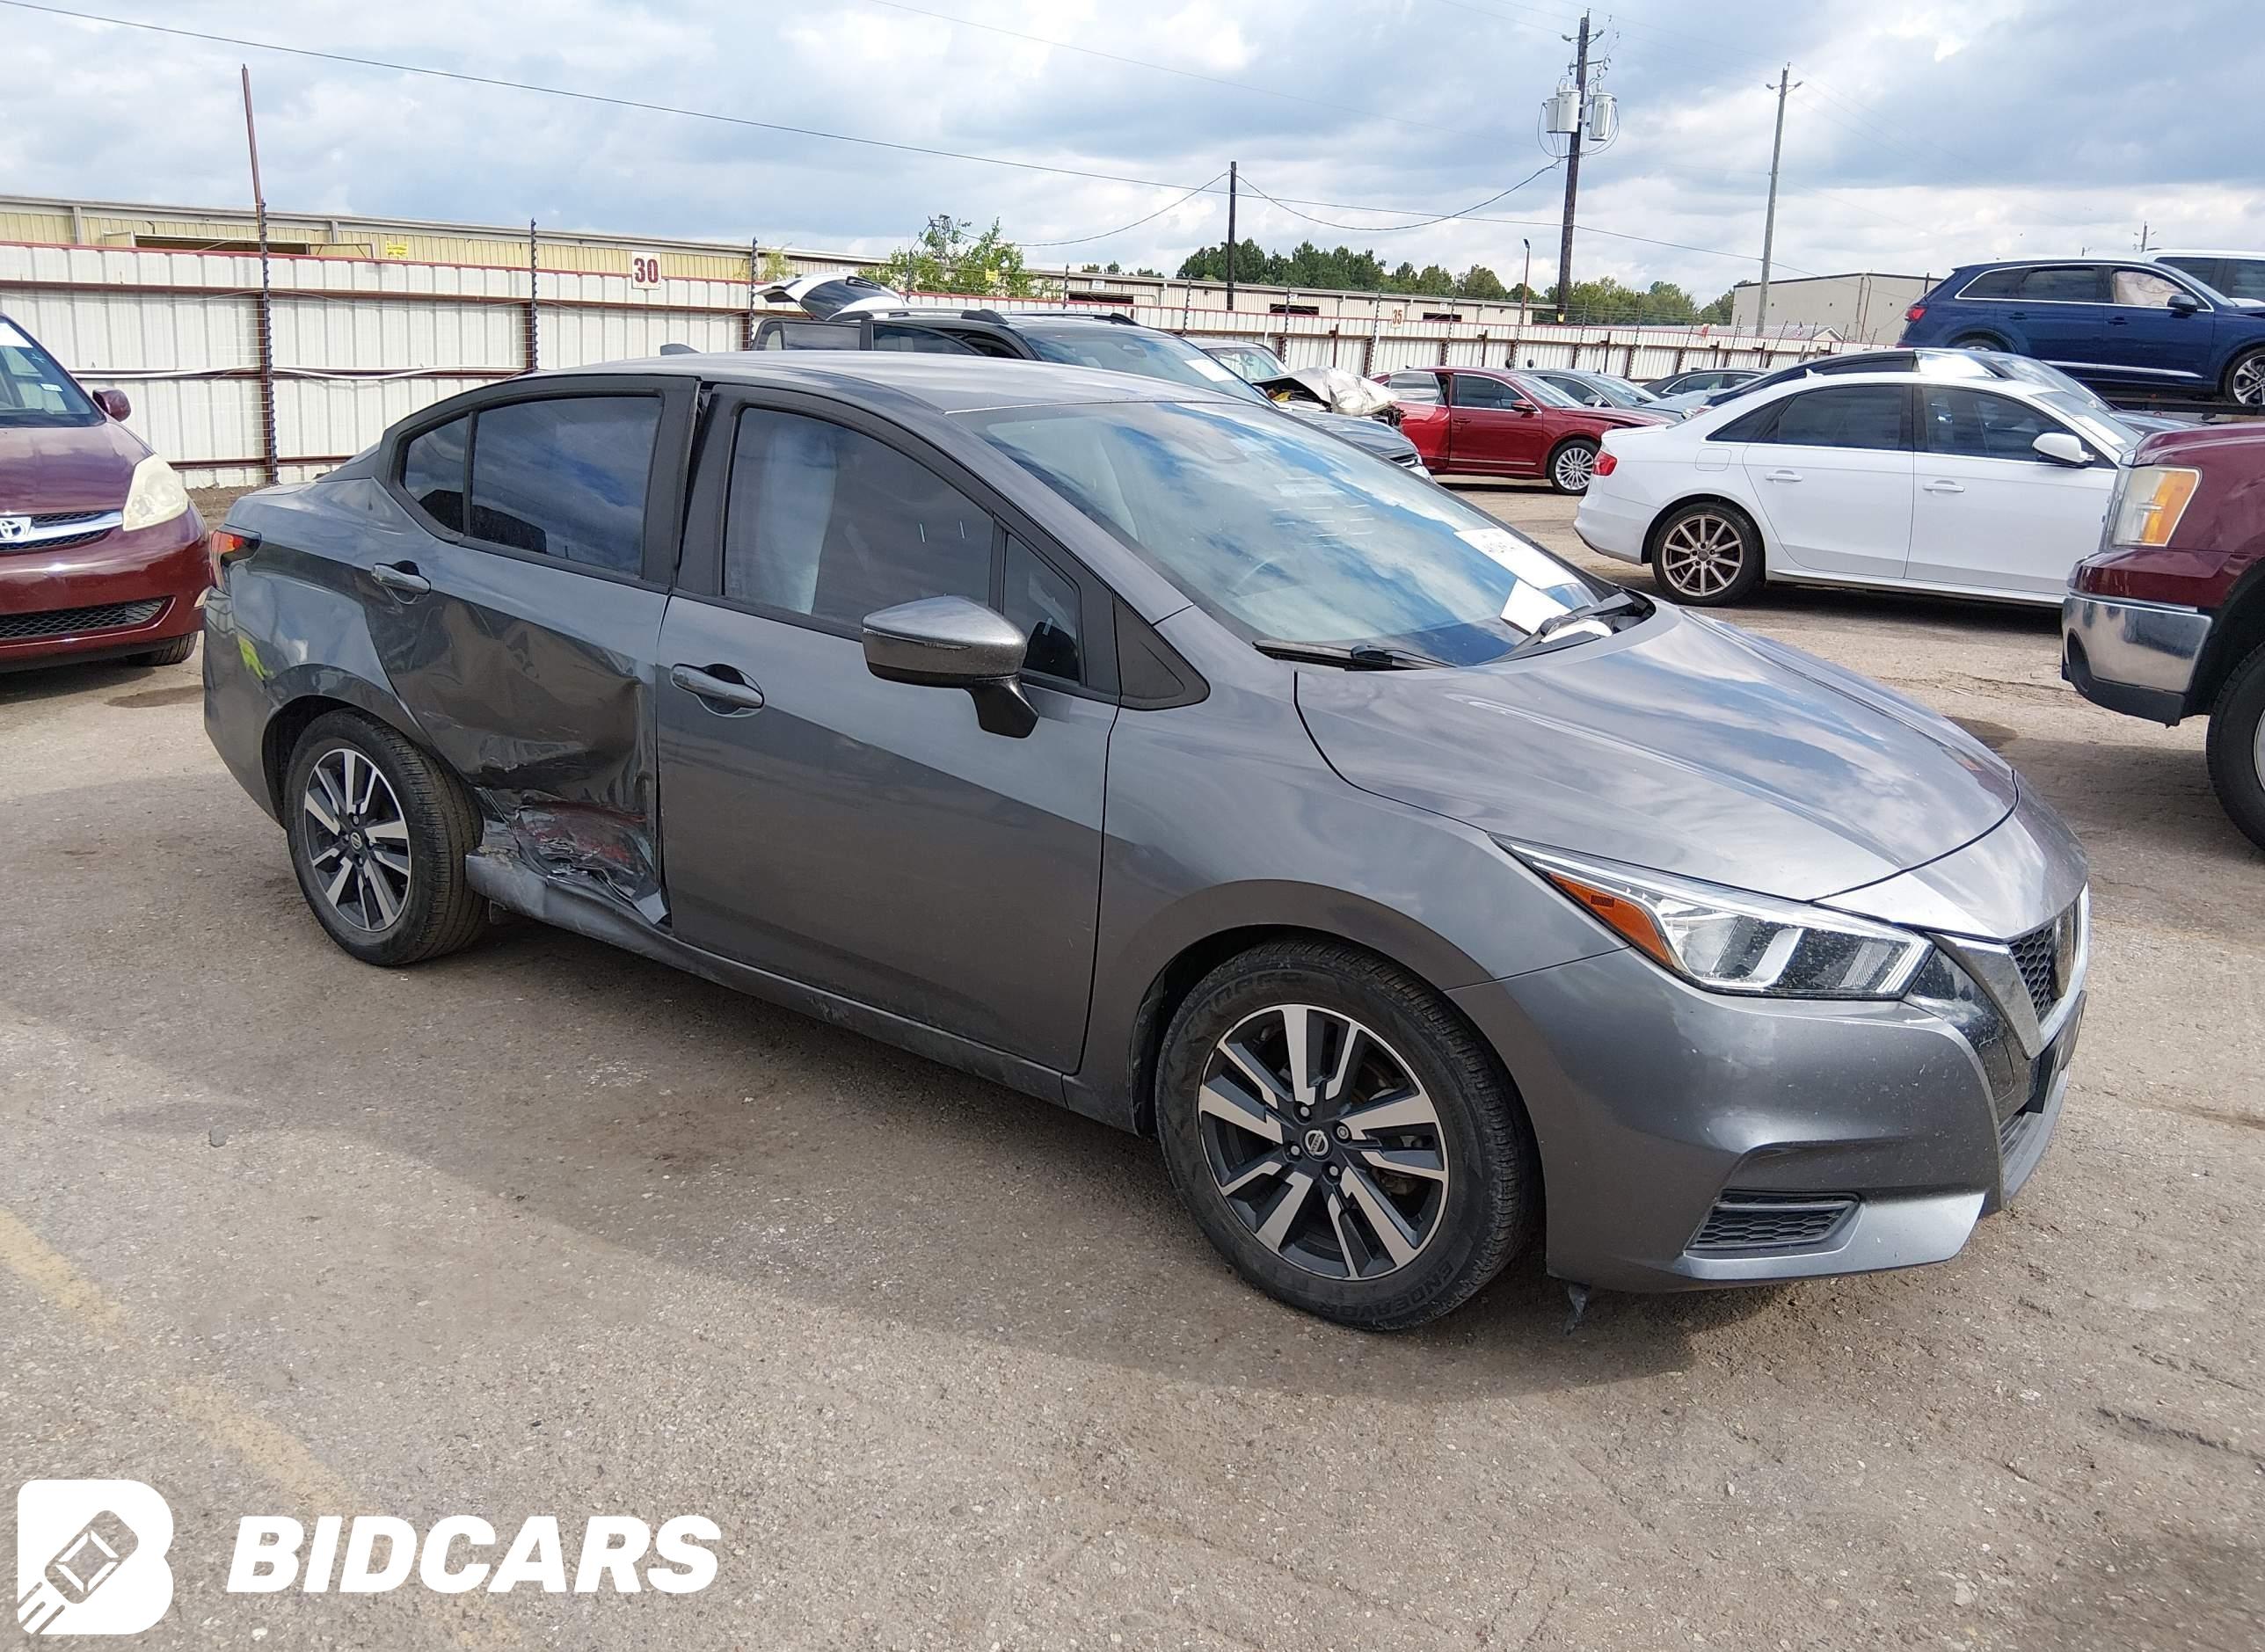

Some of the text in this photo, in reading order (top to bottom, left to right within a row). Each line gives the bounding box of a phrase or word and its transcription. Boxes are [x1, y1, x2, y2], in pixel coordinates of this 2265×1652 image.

[633, 258, 659, 284] 30
[1392, 309, 1403, 325] 35
[1319, 1263, 1455, 1318] ENDEAVOR
